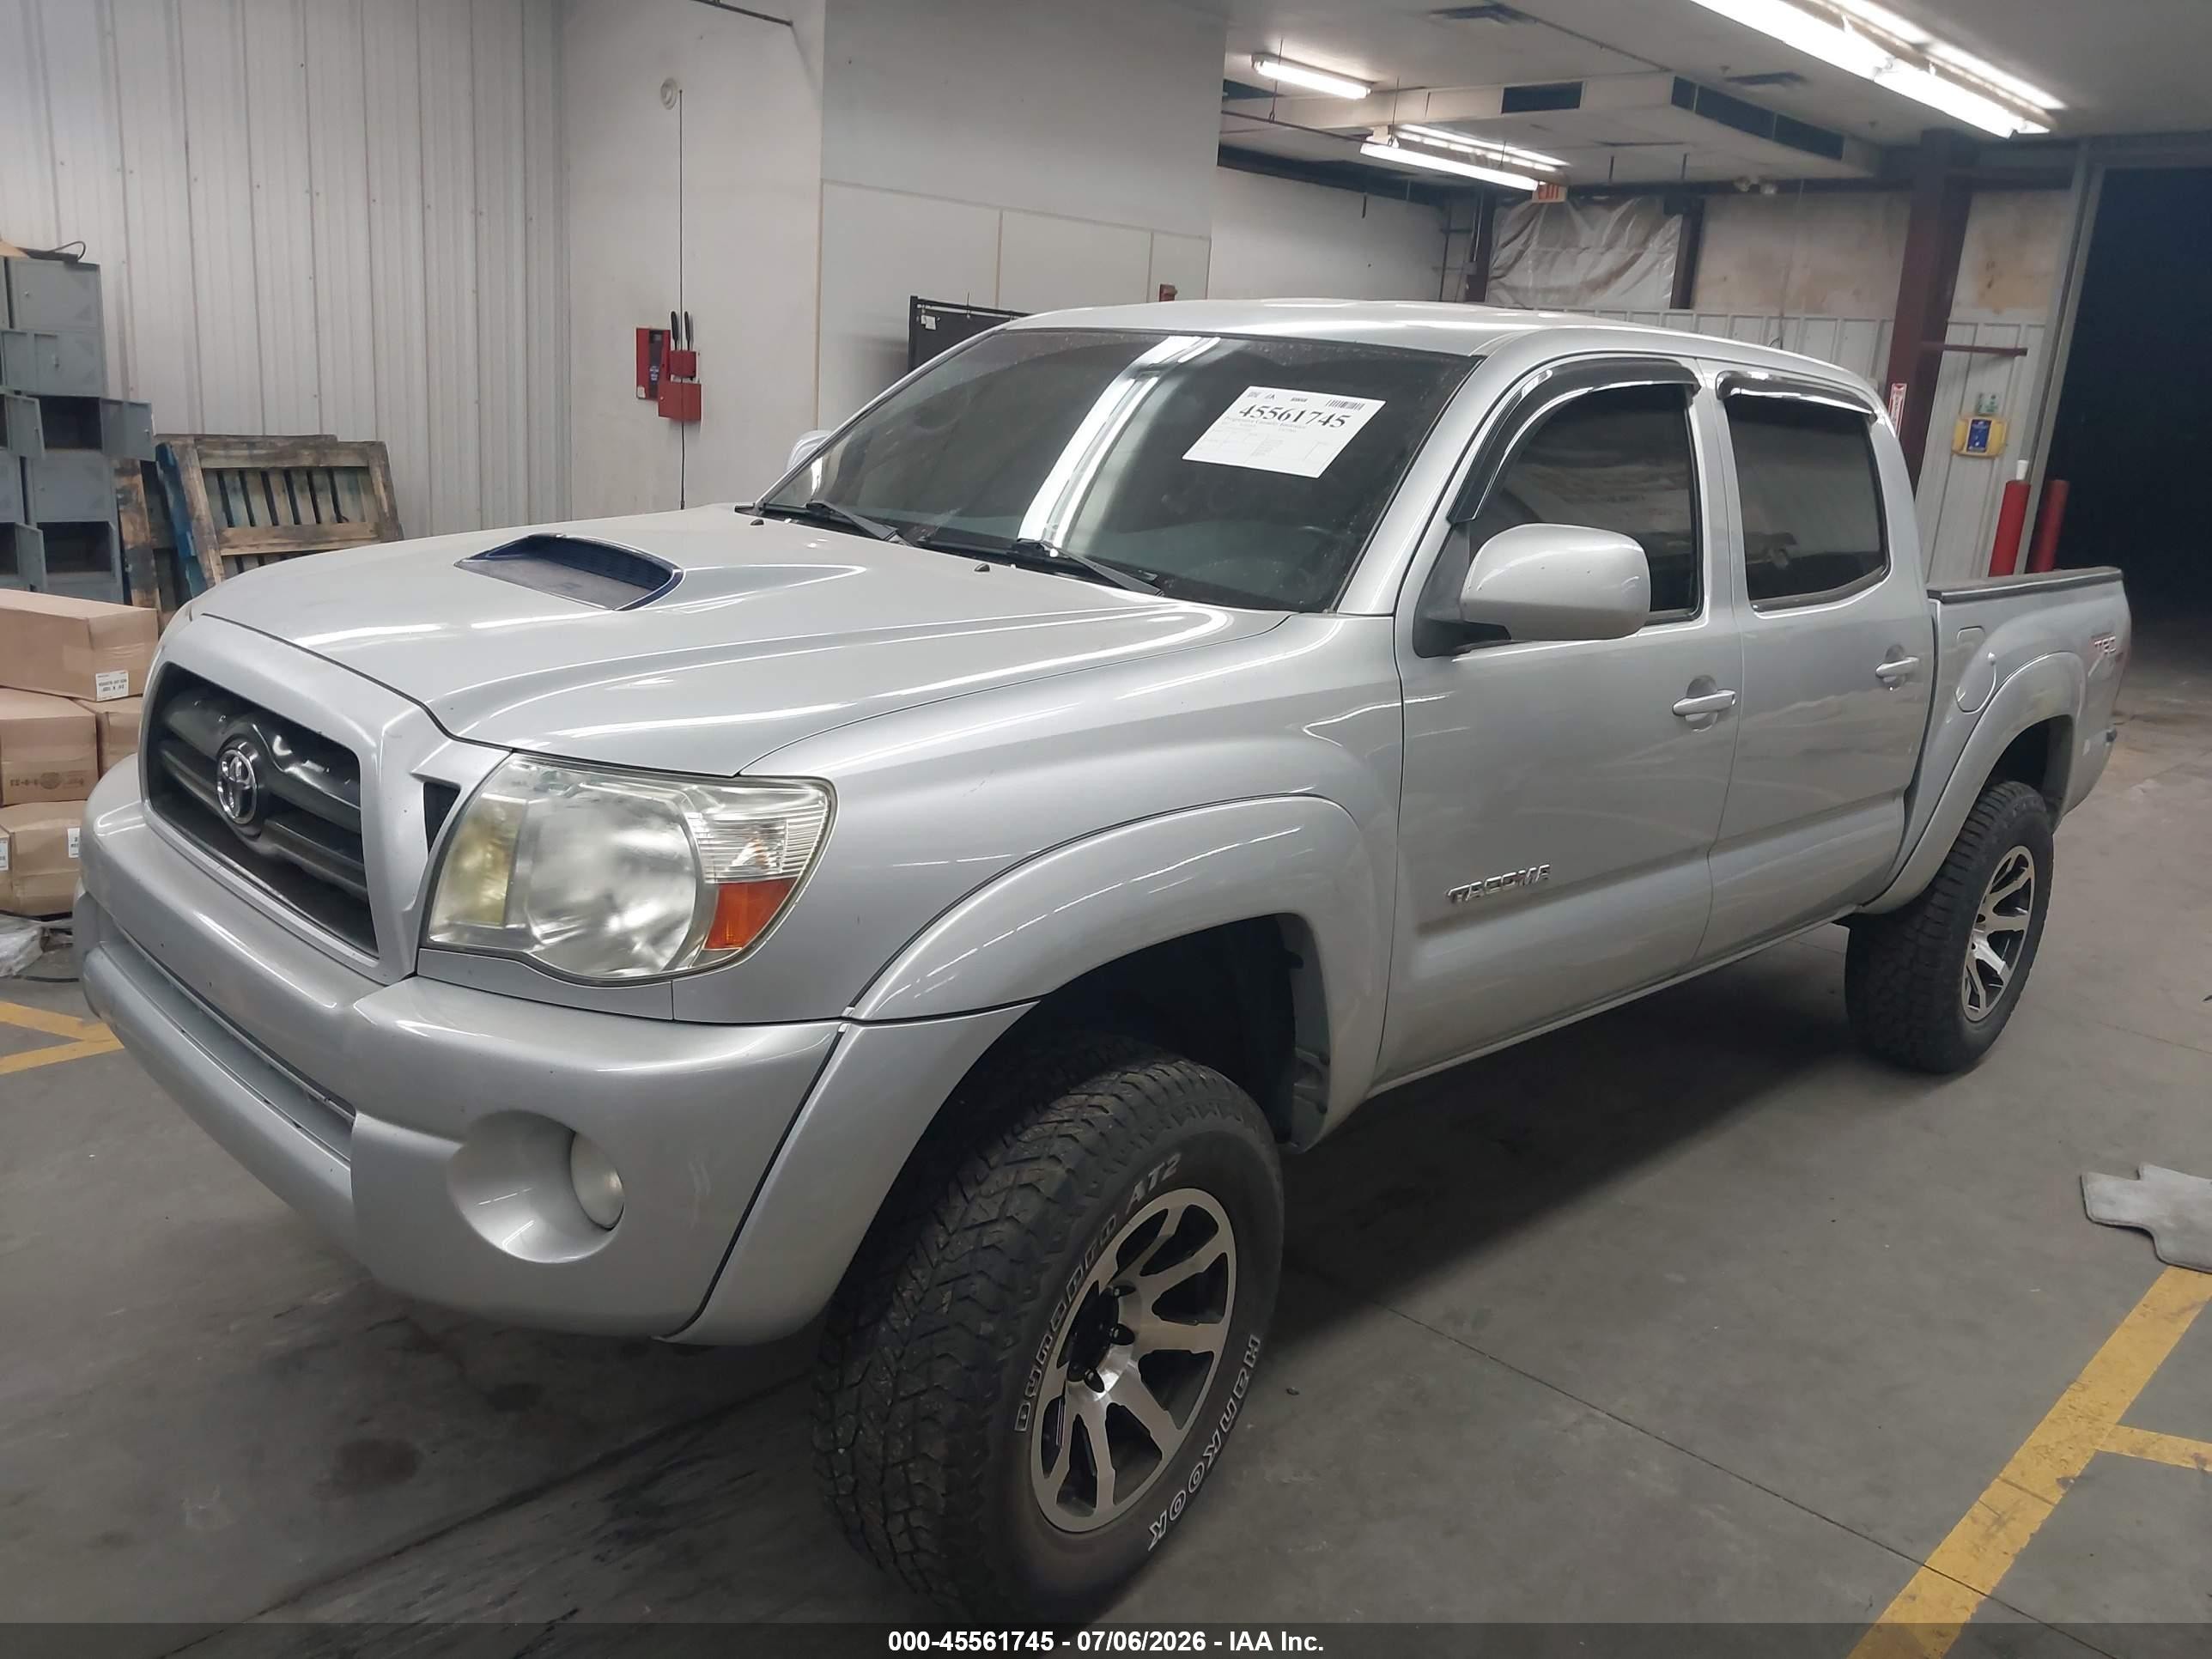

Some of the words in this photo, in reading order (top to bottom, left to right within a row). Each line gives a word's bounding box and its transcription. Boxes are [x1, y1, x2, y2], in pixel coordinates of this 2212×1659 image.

[1239, 404, 1352, 428] 45561745
[1447, 864, 1550, 902] TACOMA
[1126, 1152, 1182, 1212] AT2
